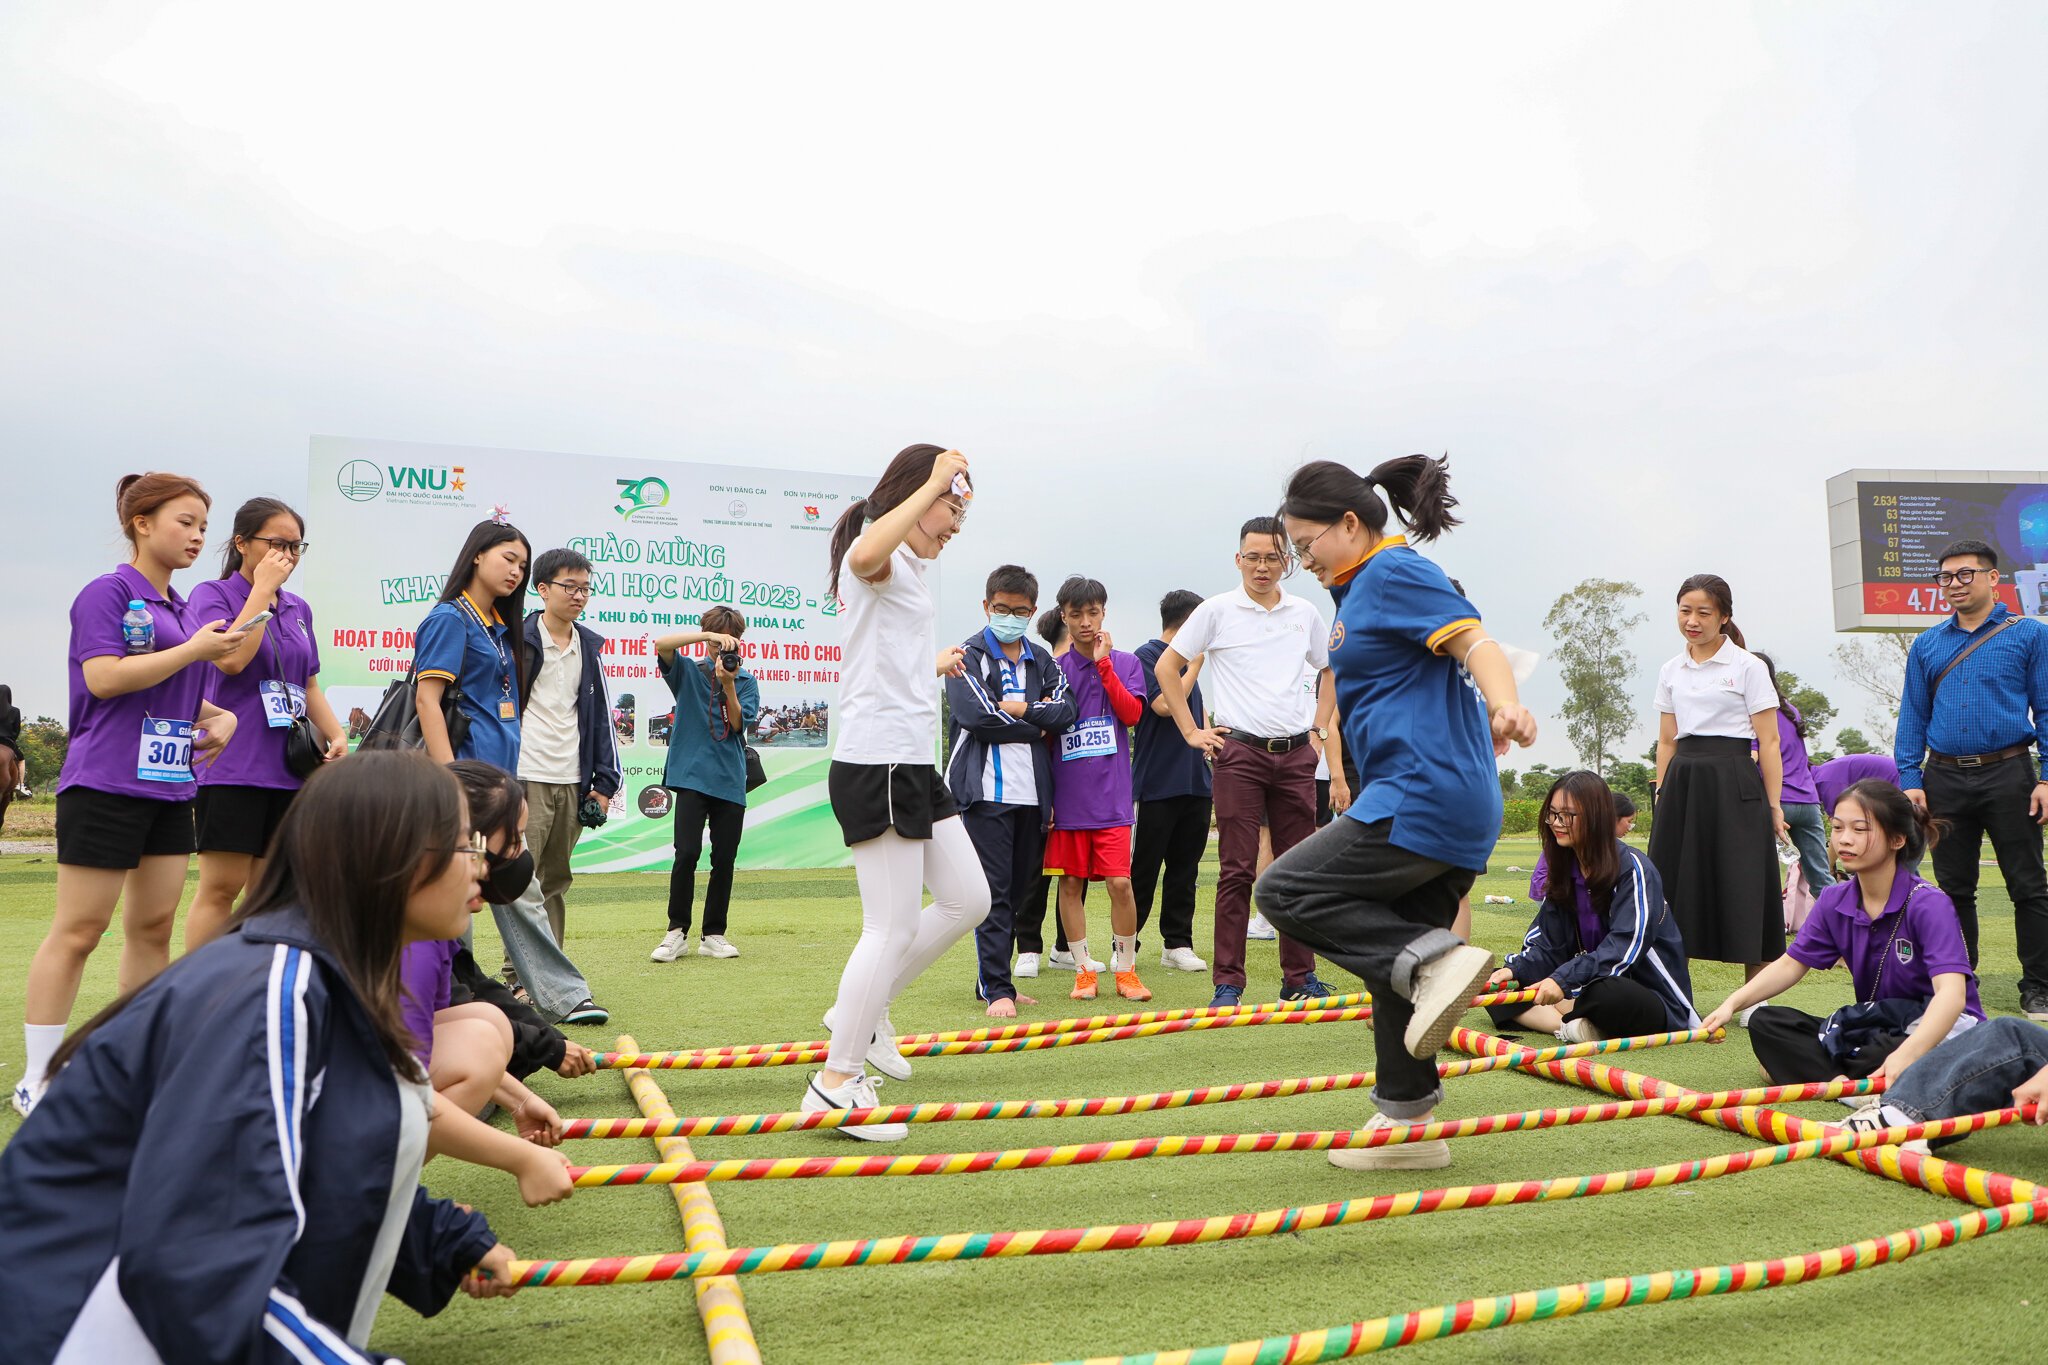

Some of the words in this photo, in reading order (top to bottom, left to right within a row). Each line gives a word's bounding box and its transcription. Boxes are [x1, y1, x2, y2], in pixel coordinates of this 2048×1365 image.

[387, 465, 447, 491] VNU
[1873, 495, 1897, 507] 2.634
[1886, 508, 1898, 520] 63
[1882, 523, 1898, 534] 141
[567, 531, 641, 563] CHÀO
[646, 535, 726, 569] MỪNG
[1887, 537, 1899, 548] 67
[1883, 551, 1899, 562] 431
[1877, 566, 1902, 577] 1.639
[622, 572, 678, 603] HỌC
[682, 572, 734, 603] MỚI
[739, 581, 801, 611] 2023
[599, 610, 626, 623] KHU
[629, 608, 649, 624] ĐÔ
[651, 612, 672, 627] THỊ
[674, 613, 701, 627] ĐHQ
[753, 613, 780, 629] HÒA
[782, 617, 806, 632] LẠC
[333, 628, 378, 652] HOẠT
[381, 627, 417, 653] ĐỘN
[620, 632, 648, 656] THỂ
[760, 639, 780, 660] VÀ
[783, 640, 810, 661] TRÒ
[368, 656, 394, 672] CƯỠI
[603, 663, 625, 678] NÉM
[627, 663, 647, 679] CÒN
[766, 669, 790, 682] KHEO
[797, 669, 812, 685] BỊT
[813, 666, 832, 683] MẮT
[1066, 730, 1111, 751] 30.255
[148, 740, 190, 766] 30.0
